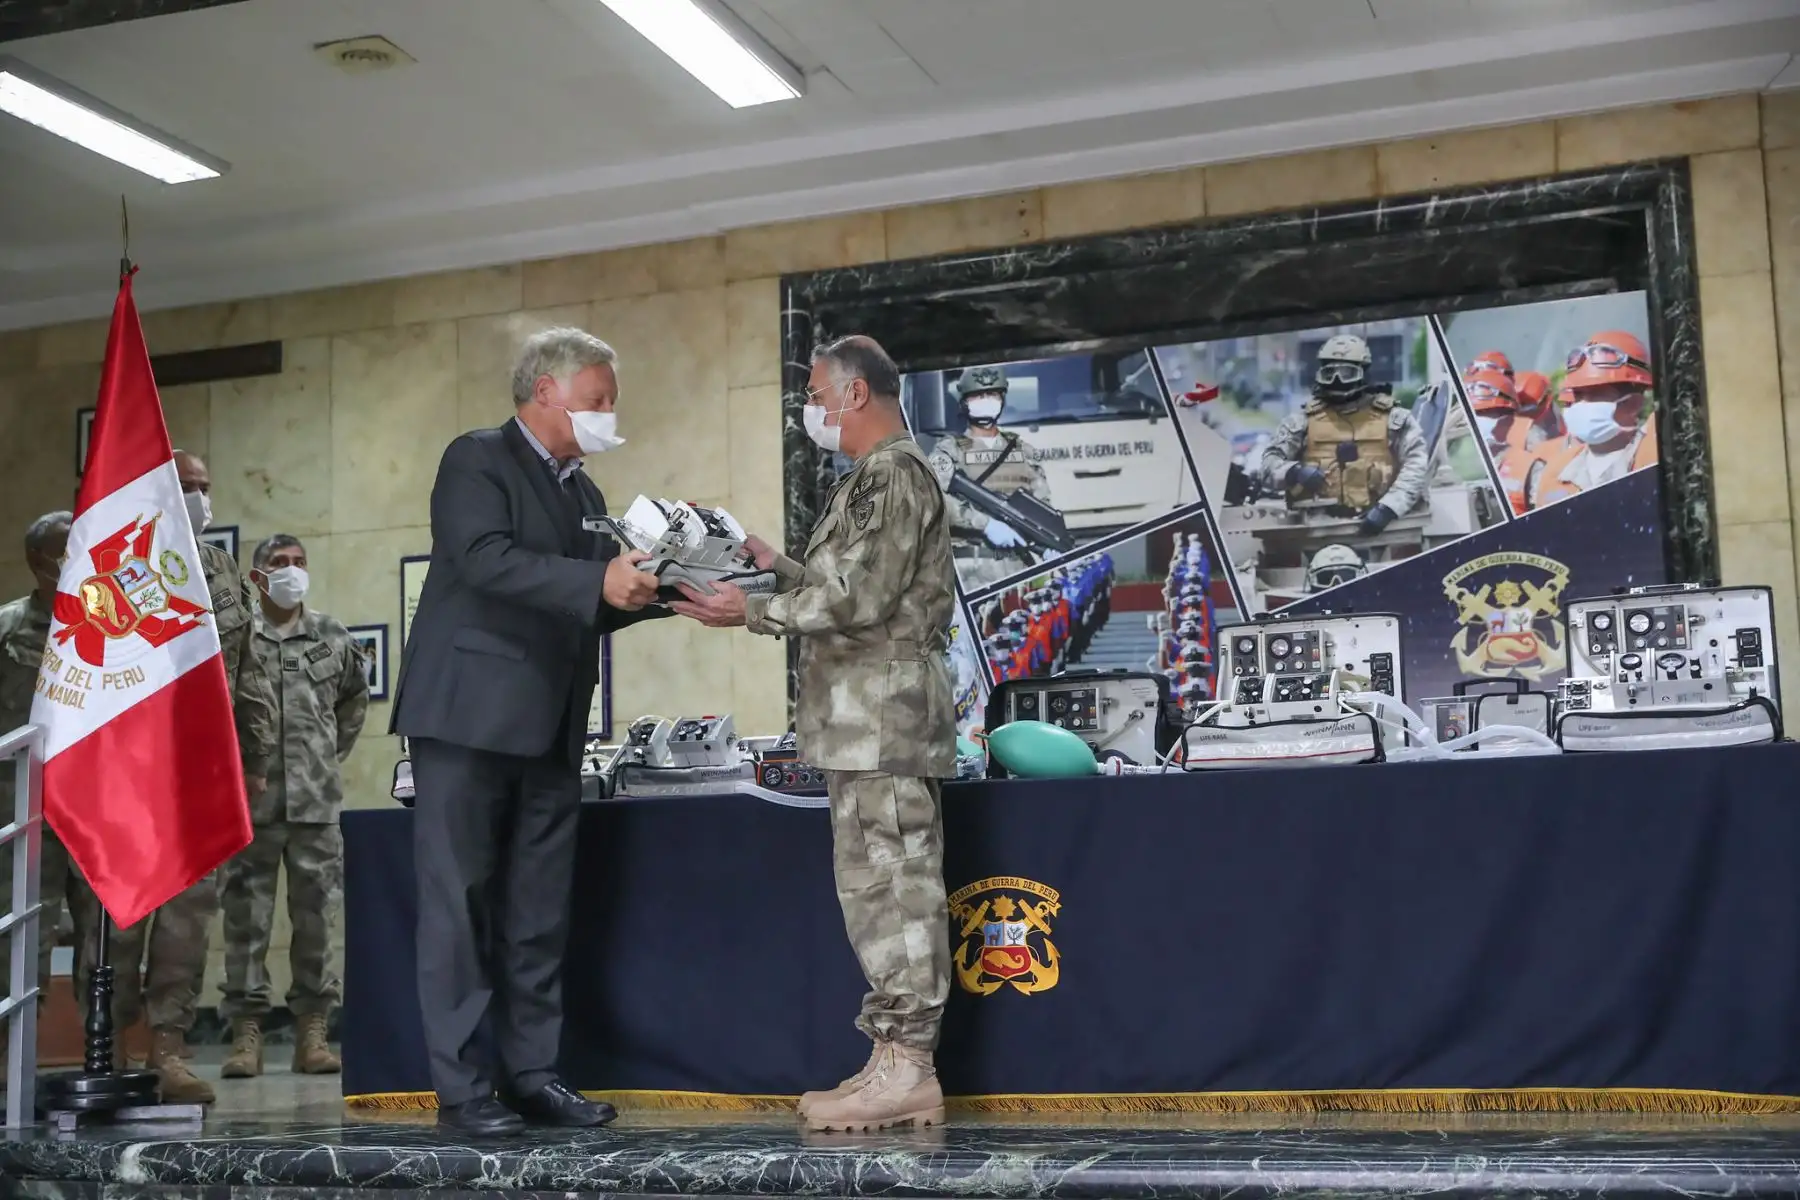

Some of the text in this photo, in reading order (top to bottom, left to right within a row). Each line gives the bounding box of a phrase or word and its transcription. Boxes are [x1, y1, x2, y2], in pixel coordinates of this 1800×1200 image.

[1073, 444, 1083, 459] DE
[1085, 443, 1116, 458] GUERRA
[1118, 442, 1132, 456] DEL
[64, 665, 92, 690] DEL
[102, 665, 145, 690] PERU
[45, 683, 84, 709] NAVAL
[950, 878, 1057, 904] MARINA DE GUERRA DEL PERU
